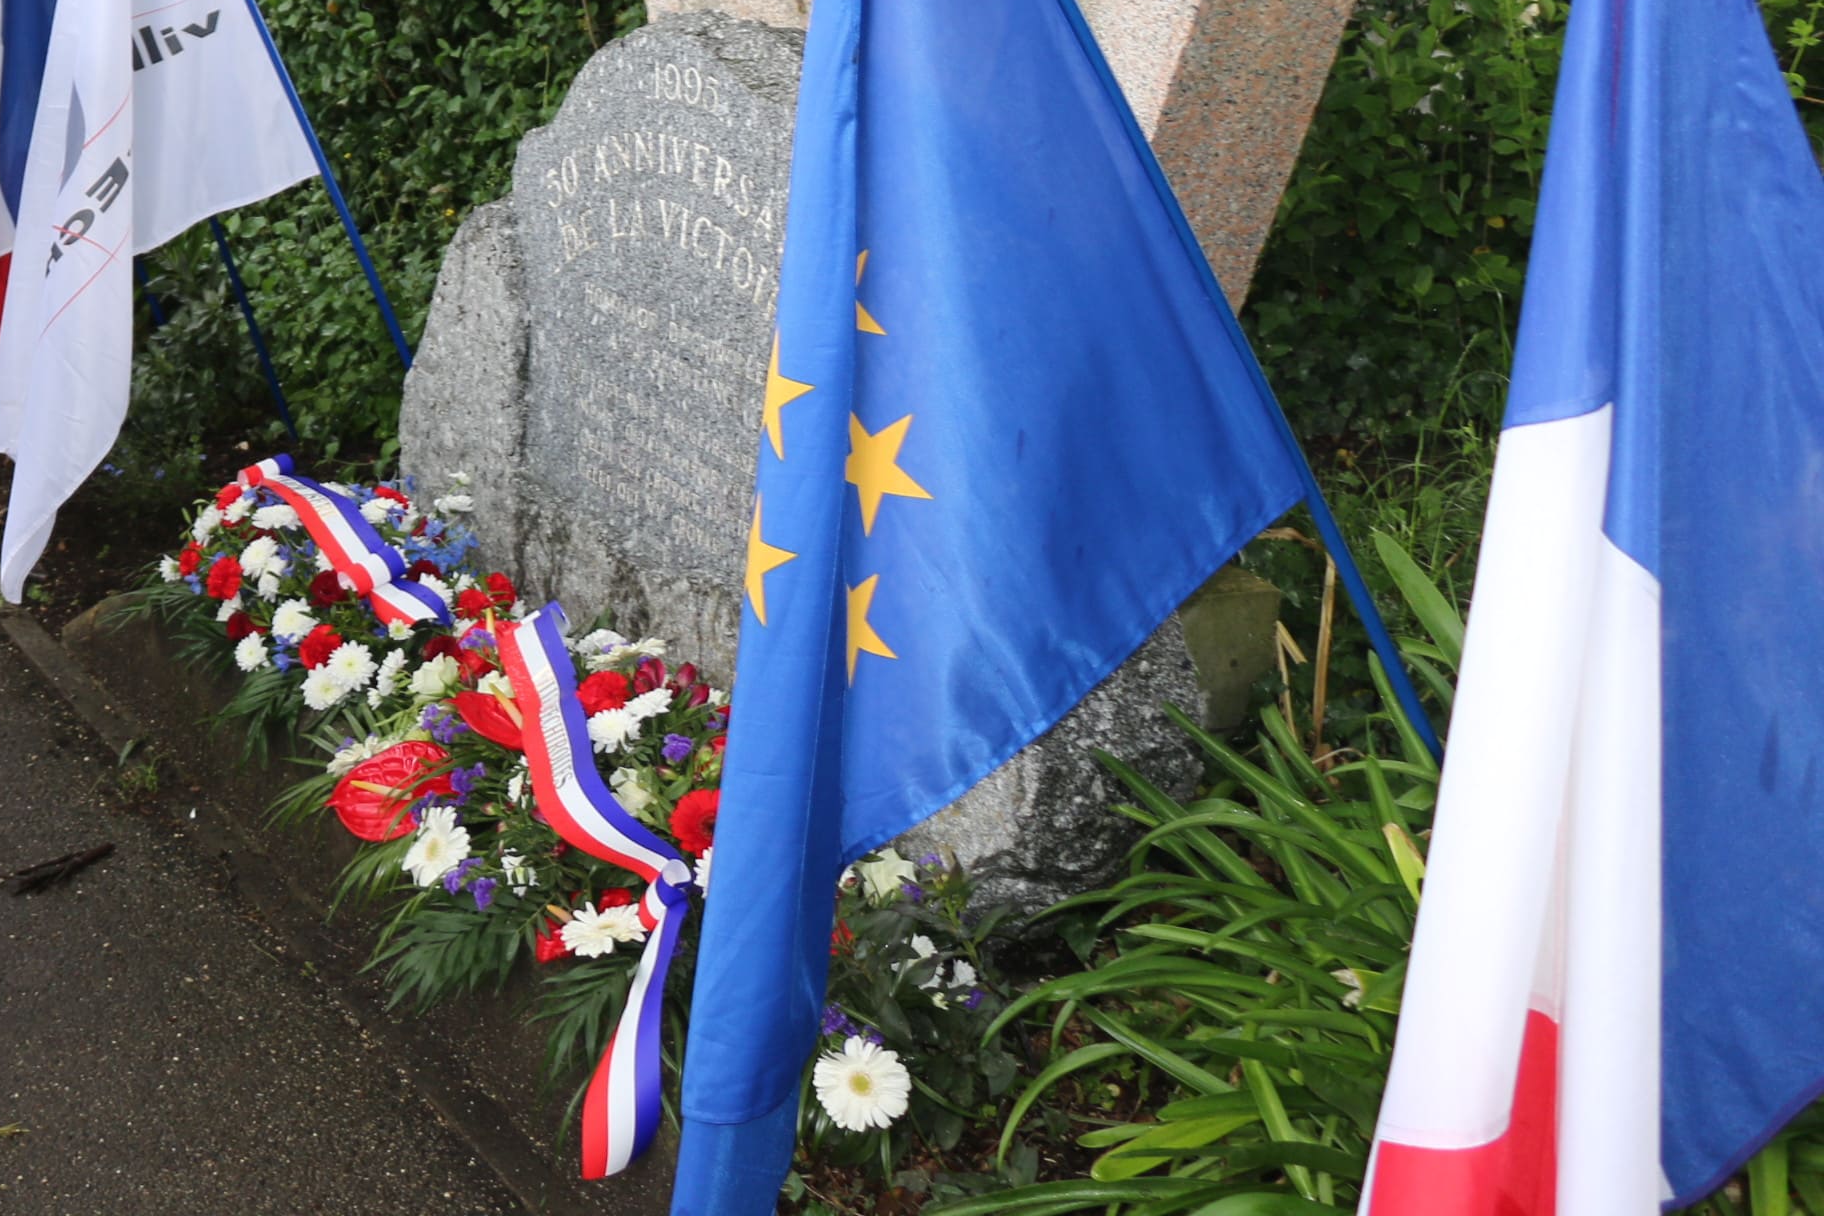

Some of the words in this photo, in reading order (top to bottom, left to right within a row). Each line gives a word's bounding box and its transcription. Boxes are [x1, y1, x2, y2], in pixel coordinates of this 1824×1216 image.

[645, 60, 721, 115] 1995
[593, 131, 775, 243] ANNIVERSA
[560, 208, 599, 263] DE
[609, 198, 645, 239] LA
